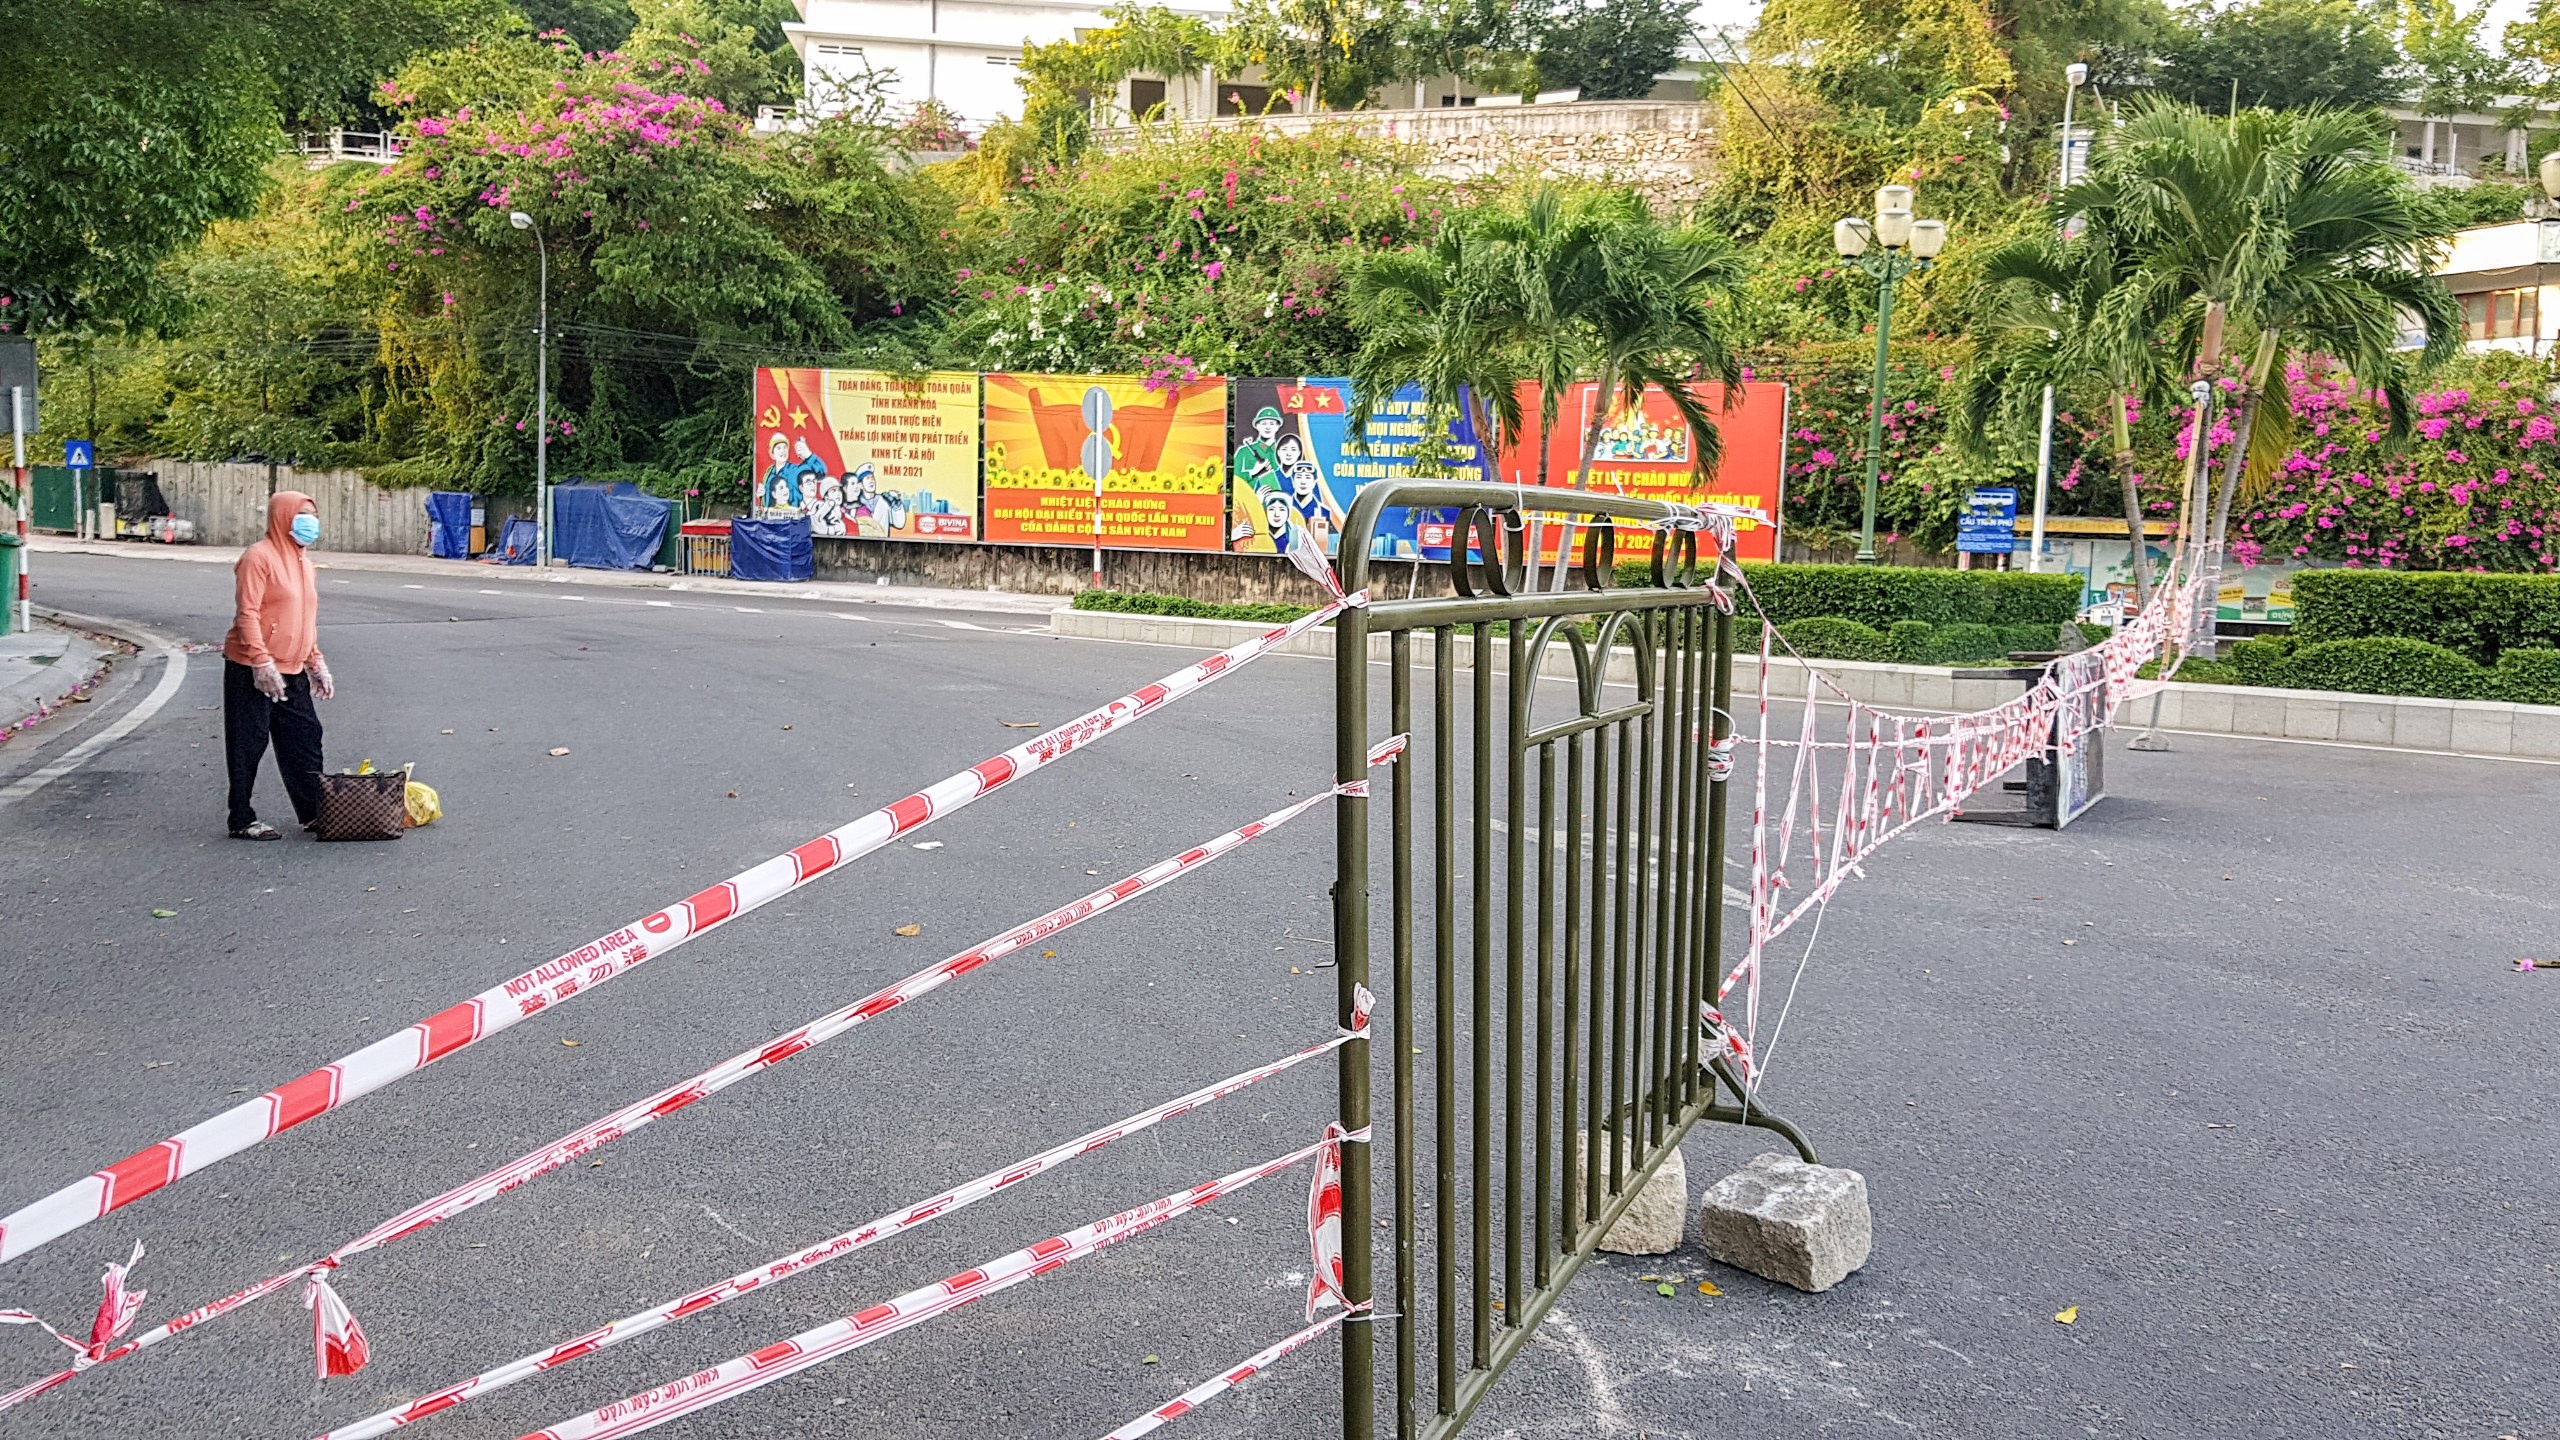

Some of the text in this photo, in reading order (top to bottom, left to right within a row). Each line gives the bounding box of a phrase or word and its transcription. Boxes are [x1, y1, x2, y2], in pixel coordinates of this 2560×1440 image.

[866, 414, 879, 425] THI
[922, 415, 942, 430] HIỆN
[881, 430, 908, 446] NHIỆM
[922, 431, 943, 445] PHÁT
[871, 448, 891, 460] KINH
[892, 446, 904, 460] TẾ
[920, 448, 935, 463] HỘI
[903, 466, 923, 478] 2021
[1333, 459, 1355, 477] CỦA
[1356, 461, 1387, 477] NHÂN
[1632, 470, 1666, 487] CHÀO
[1040, 495, 1167, 510] NHIỆT LIỆT CHÀO MỪNG
[938, 517, 968, 527] BIVINA
[994, 508, 1013, 520] ĐẠI
[1014, 507, 1034, 521] HỘI
[1035, 509, 1055, 522] ĐẠI
[1056, 507, 1083, 521] BIỂU
[1115, 510, 1147, 524] QUỐC
[1170, 513, 1195, 526] THỨ
[1195, 515, 1216, 526] XIII
[1020, 520, 1044, 533] CỦA
[1044, 521, 1075, 534] ĐẢNG
[1108, 523, 1132, 536] SẢN
[1132, 525, 1160, 538] VIỆT
[1160, 527, 1187, 538] NAM
[503, 928, 639, 999] NOT ALLOWED AREA
